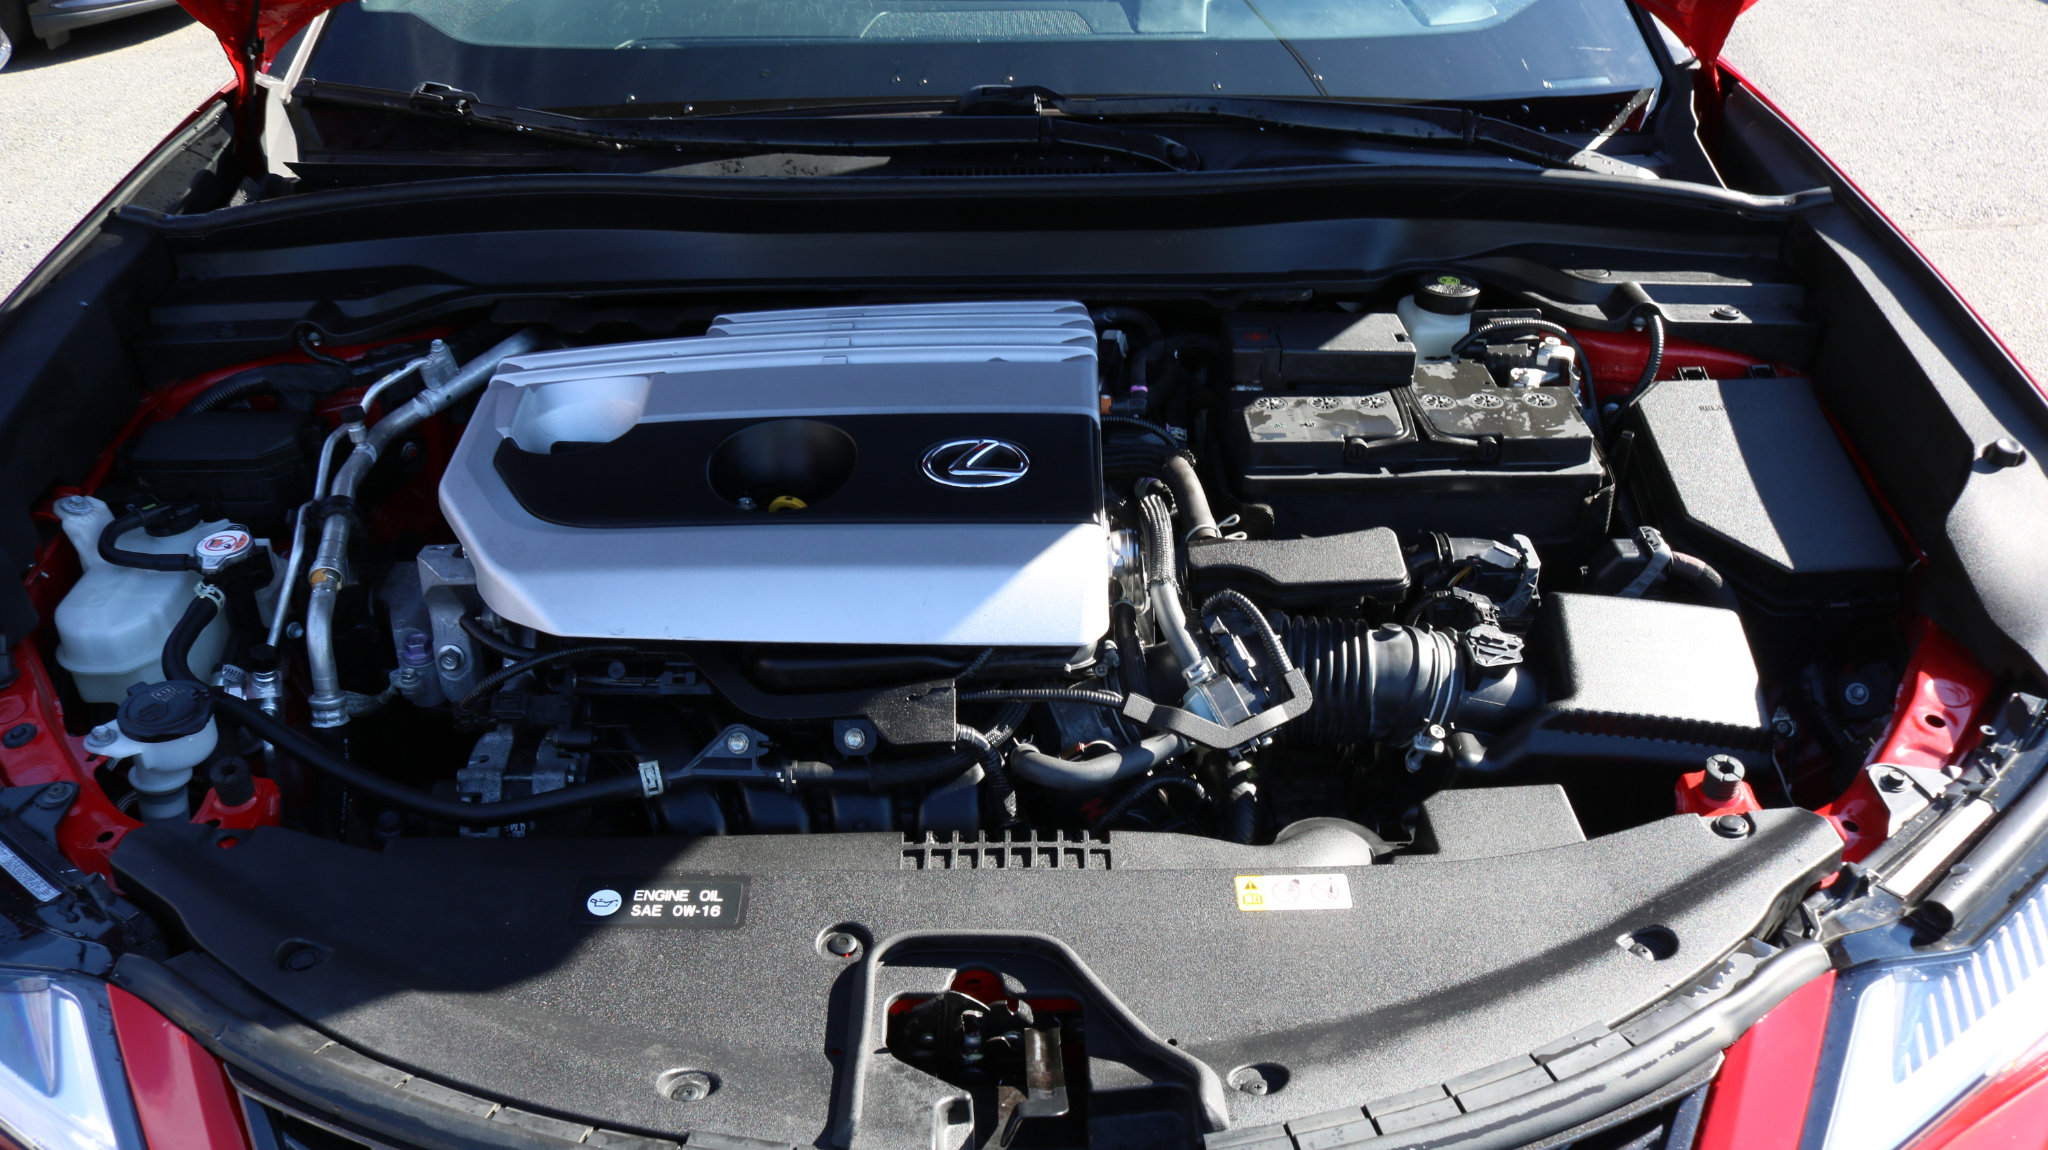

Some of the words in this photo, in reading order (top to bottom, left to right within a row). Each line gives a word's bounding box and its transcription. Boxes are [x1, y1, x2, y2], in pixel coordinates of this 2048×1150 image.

[634, 889, 690, 902] ENGINE
[700, 889, 724, 902] OIL
[631, 904, 664, 917] SAE
